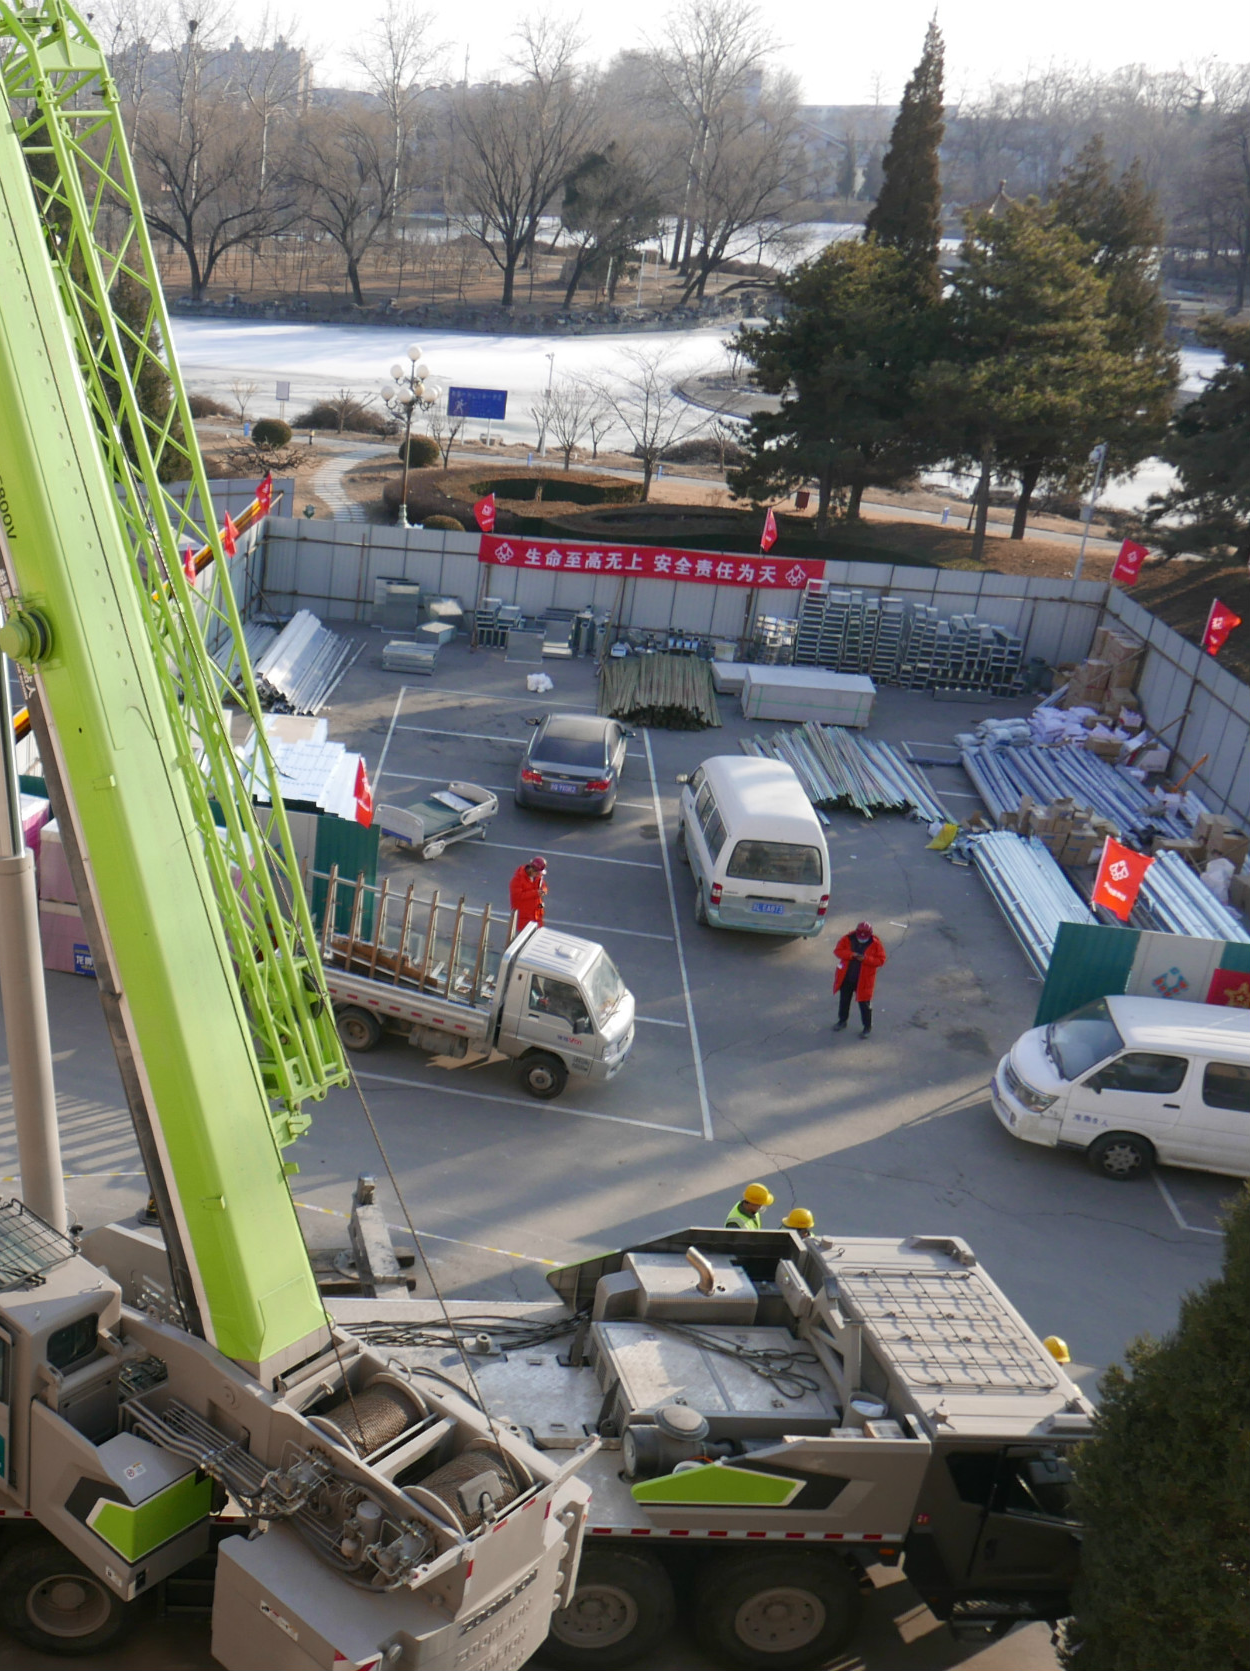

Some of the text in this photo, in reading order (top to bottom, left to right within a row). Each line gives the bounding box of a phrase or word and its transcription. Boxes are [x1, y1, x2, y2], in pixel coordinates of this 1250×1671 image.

[525, 547, 777, 583] 生命至高无上 安全责任为天
